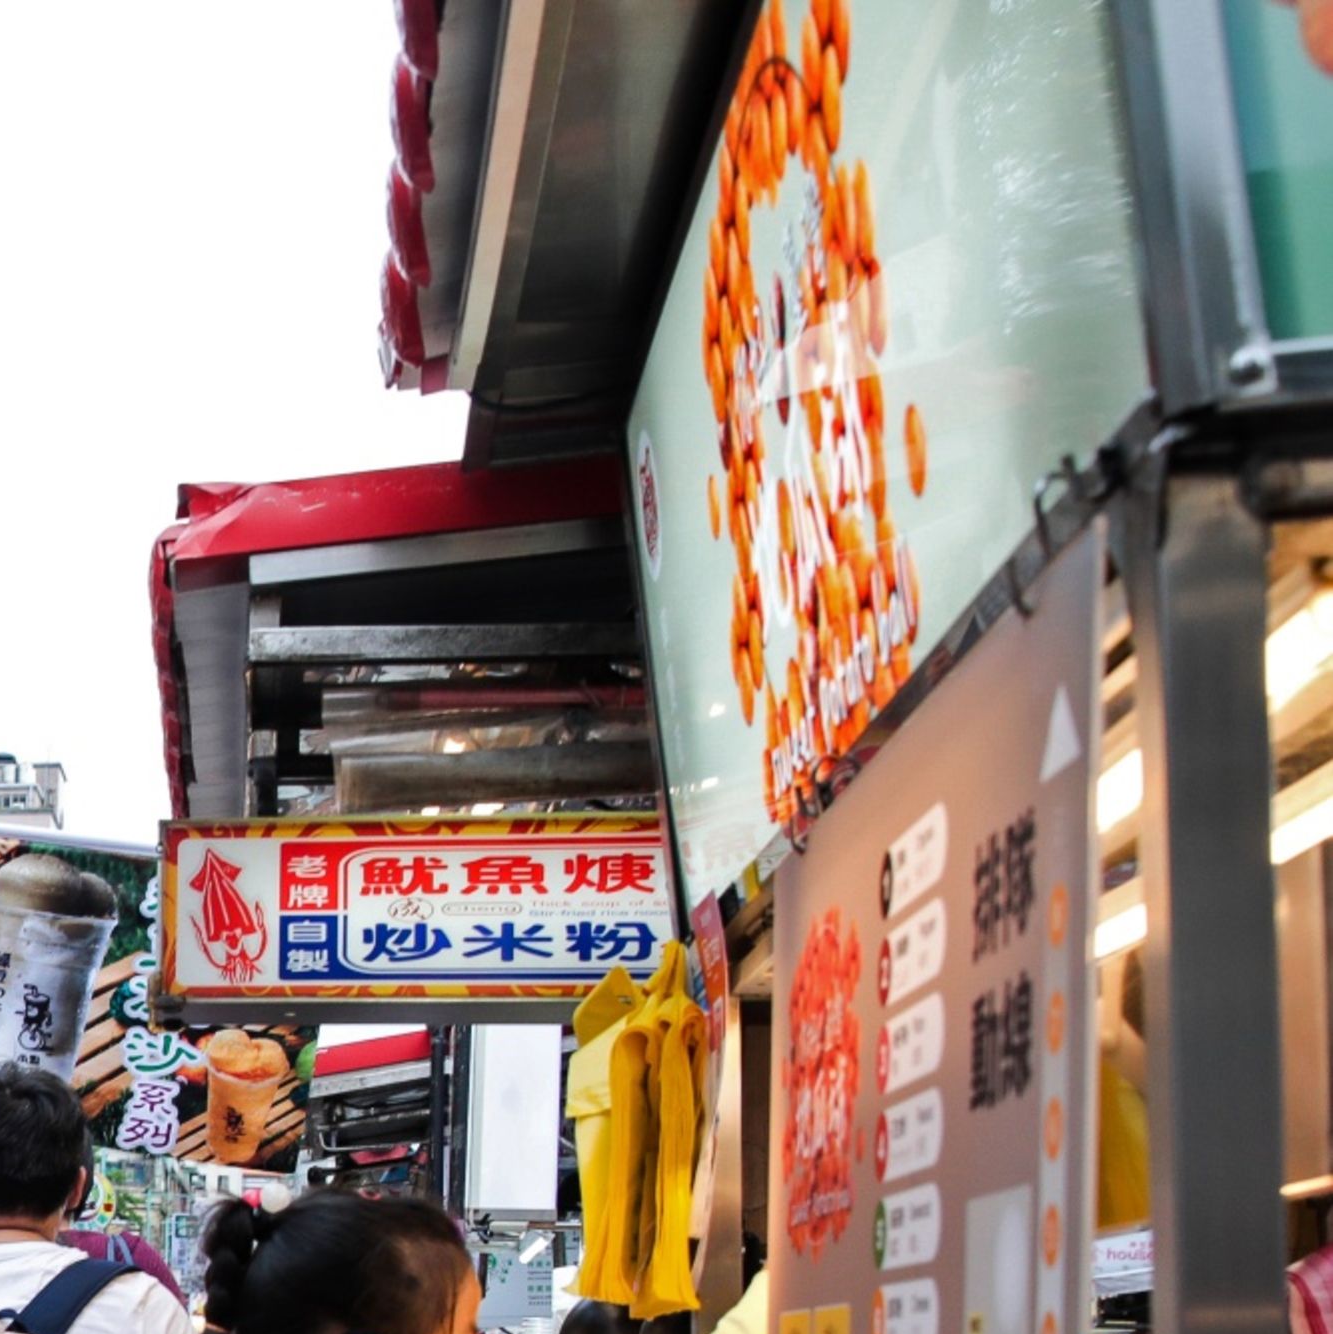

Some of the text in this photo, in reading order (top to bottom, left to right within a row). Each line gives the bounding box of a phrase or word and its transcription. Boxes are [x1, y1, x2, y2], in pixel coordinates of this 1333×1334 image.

[287, 855, 329, 908] 老牌
[286, 921, 329, 973] 自製
[362, 921, 658, 963] 炒米粉
